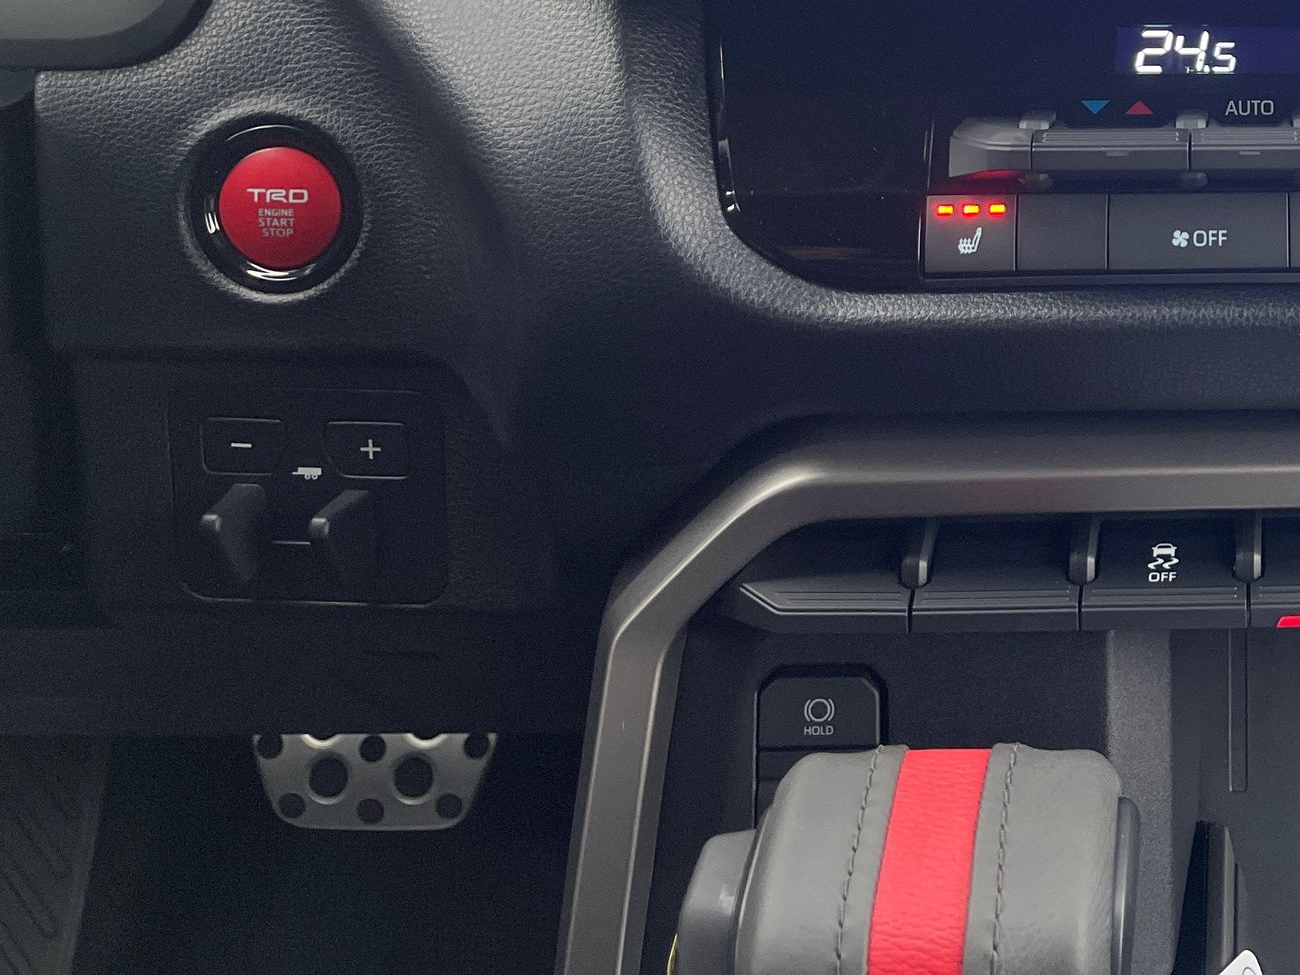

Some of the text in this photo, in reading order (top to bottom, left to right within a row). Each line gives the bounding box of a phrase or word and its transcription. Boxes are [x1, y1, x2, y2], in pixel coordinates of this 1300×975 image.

[1135, 30, 1236, 73] 24.5
[1225, 99, 1275, 115] AUTO
[247, 187, 309, 203] TRD
[258, 208, 294, 217] ENGINE
[258, 217, 294, 227] START
[262, 228, 294, 237] STOP
[1193, 230, 1228, 247] OFF
[1148, 571, 1176, 582] OFF
[804, 726, 834, 735] HOLD
